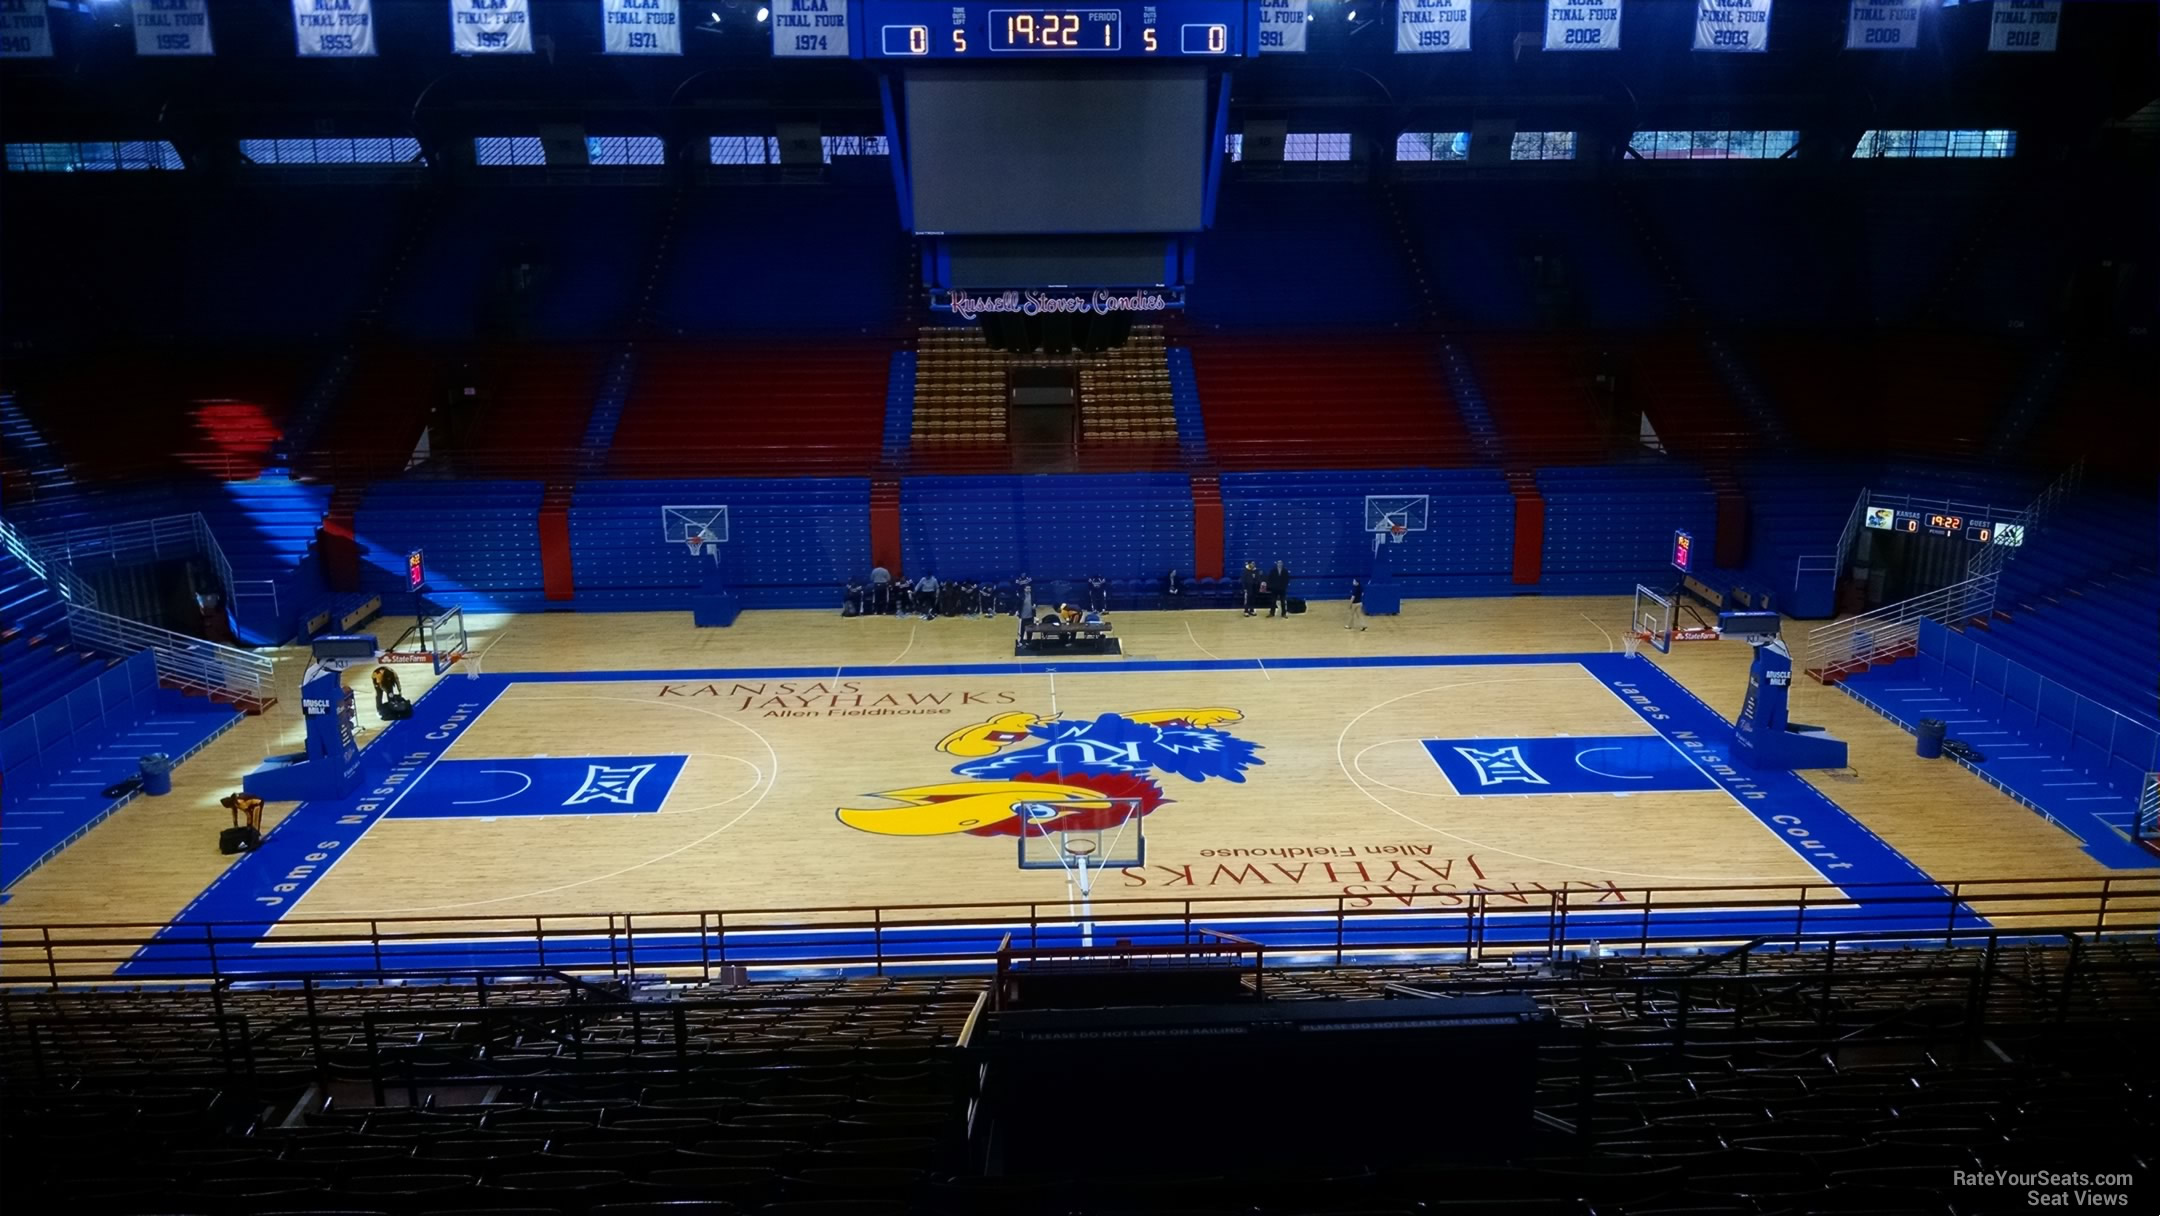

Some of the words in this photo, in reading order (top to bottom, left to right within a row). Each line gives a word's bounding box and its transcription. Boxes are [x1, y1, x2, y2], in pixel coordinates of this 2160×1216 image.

[791, 0, 828, 11] NCAA
[137, 14, 168, 26] FINAL
[174, 14, 204, 26] FOUR
[300, 15, 335, 26] FINAL
[339, 14, 368, 26] FOUR
[457, 12, 491, 24] FINAL
[495, 11, 525, 23] FOUR
[607, 12, 642, 24] FINAL
[646, 12, 676, 24] FOUR
[776, 15, 811, 27] FINAL
[815, 15, 844, 27] FOUR
[1089, 12, 1117, 22] PERIOD
[1275, 11, 1303, 23] FOUR
[1402, 11, 1436, 24] FINAL
[1439, 9, 1467, 22] FOUR
[1552, 9, 1586, 21] FINAL
[1588, 8, 1617, 20] FOUR
[1700, 10, 1734, 23] FINAL
[1737, 10, 1766, 22] FOUR
[1854, 8, 1887, 20] FINAL
[1891, 8, 1917, 20] FOUR
[1994, 11, 2028, 23] FINAL
[2029, 11, 2058, 23] FOUR
[1008, 15, 1079, 45] 19:22
[1105, 24, 1111, 46] 1
[1565, 28, 1601, 43] 2002
[1866, 29, 1900, 43] 2008
[628, 32, 658, 48] 1971
[795, 35, 828, 50] 1974
[909, 27, 926, 52] 0
[953, 29, 967, 51] 5
[1143, 28, 1157, 51] 5
[1209, 26, 1224, 51] 0
[1260, 31, 1284, 46] 991
[1418, 30, 1450, 46] 1993
[1714, 30, 1749, 45] 2003
[2006, 31, 2040, 46] 2012
[948, 289, 1021, 320] Russell
[1023, 289, 1090, 316] Stover
[1092, 288, 1166, 315] Candies
[1896, 510, 1921, 519] KANSAS
[1908, 520, 1917, 531] 0
[1931, 515, 1960, 529] 19:22
[1969, 519, 1991, 528] GUEST
[1980, 530, 1989, 541] 0
[658, 681, 861, 697] KANSAS
[1770, 678, 1787, 686] MILK
[737, 690, 1016, 712] JAYHAWKS
[308, 707, 326, 715] MILK
[763, 708, 822, 718] Allen
[828, 707, 952, 718] Fieldhouse
[1042, 739, 1148, 764] KU
[1614, 681, 1670, 721] James
[1671, 731, 1768, 800] Naismith
[1772, 814, 1854, 870] Court
[256, 840, 341, 906] James
[335, 752, 431, 825] Naismith
[425, 702, 480, 740] Court
[1200, 845, 1356, 858] Fieldhouse
[1364, 844, 1434, 856] Allen
[1120, 854, 1488, 888] JAYHAWKS
[1030, 1032, 1077, 1041] PLEASE
[1080, 1031, 1097, 1040] DO
[1102, 1031, 1128, 1039] NOT
[1170, 1028, 1190, 1037] ON
